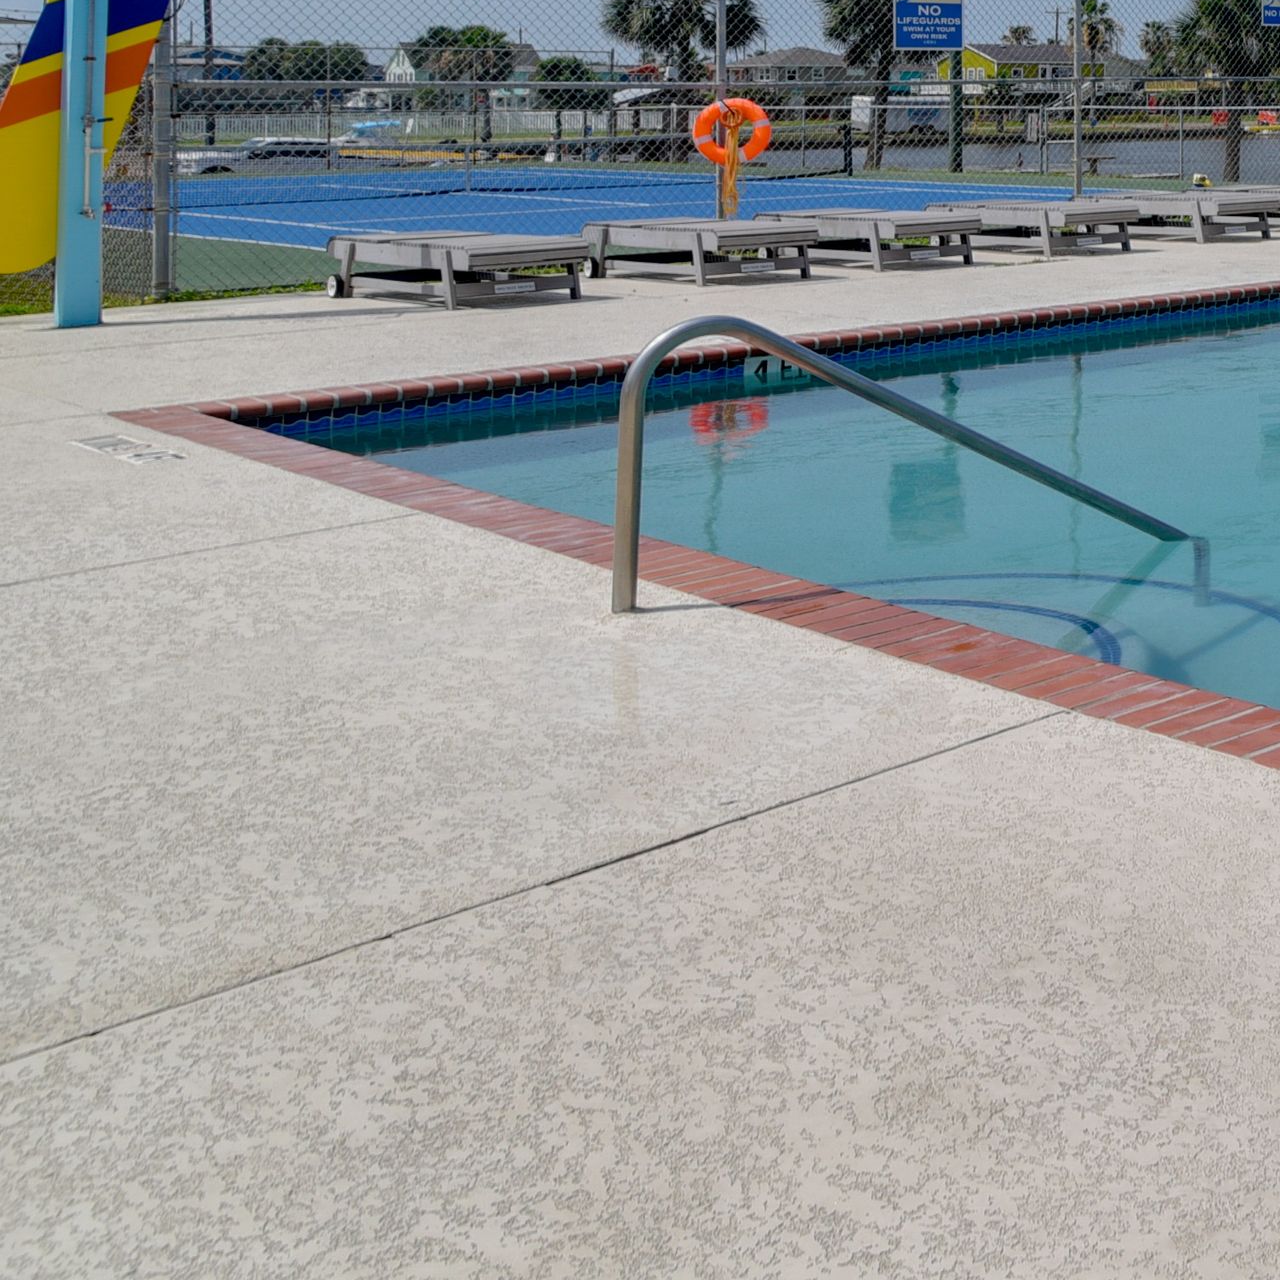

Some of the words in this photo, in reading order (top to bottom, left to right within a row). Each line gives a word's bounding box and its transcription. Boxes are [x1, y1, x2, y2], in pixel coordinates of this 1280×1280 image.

[918, 4, 942, 16] NO
[1264, 9, 1278, 17] NO
[897, 16, 961, 25] LIFEGUARDS
[902, 25, 923, 33] SWIM
[924, 25, 935, 33] AT
